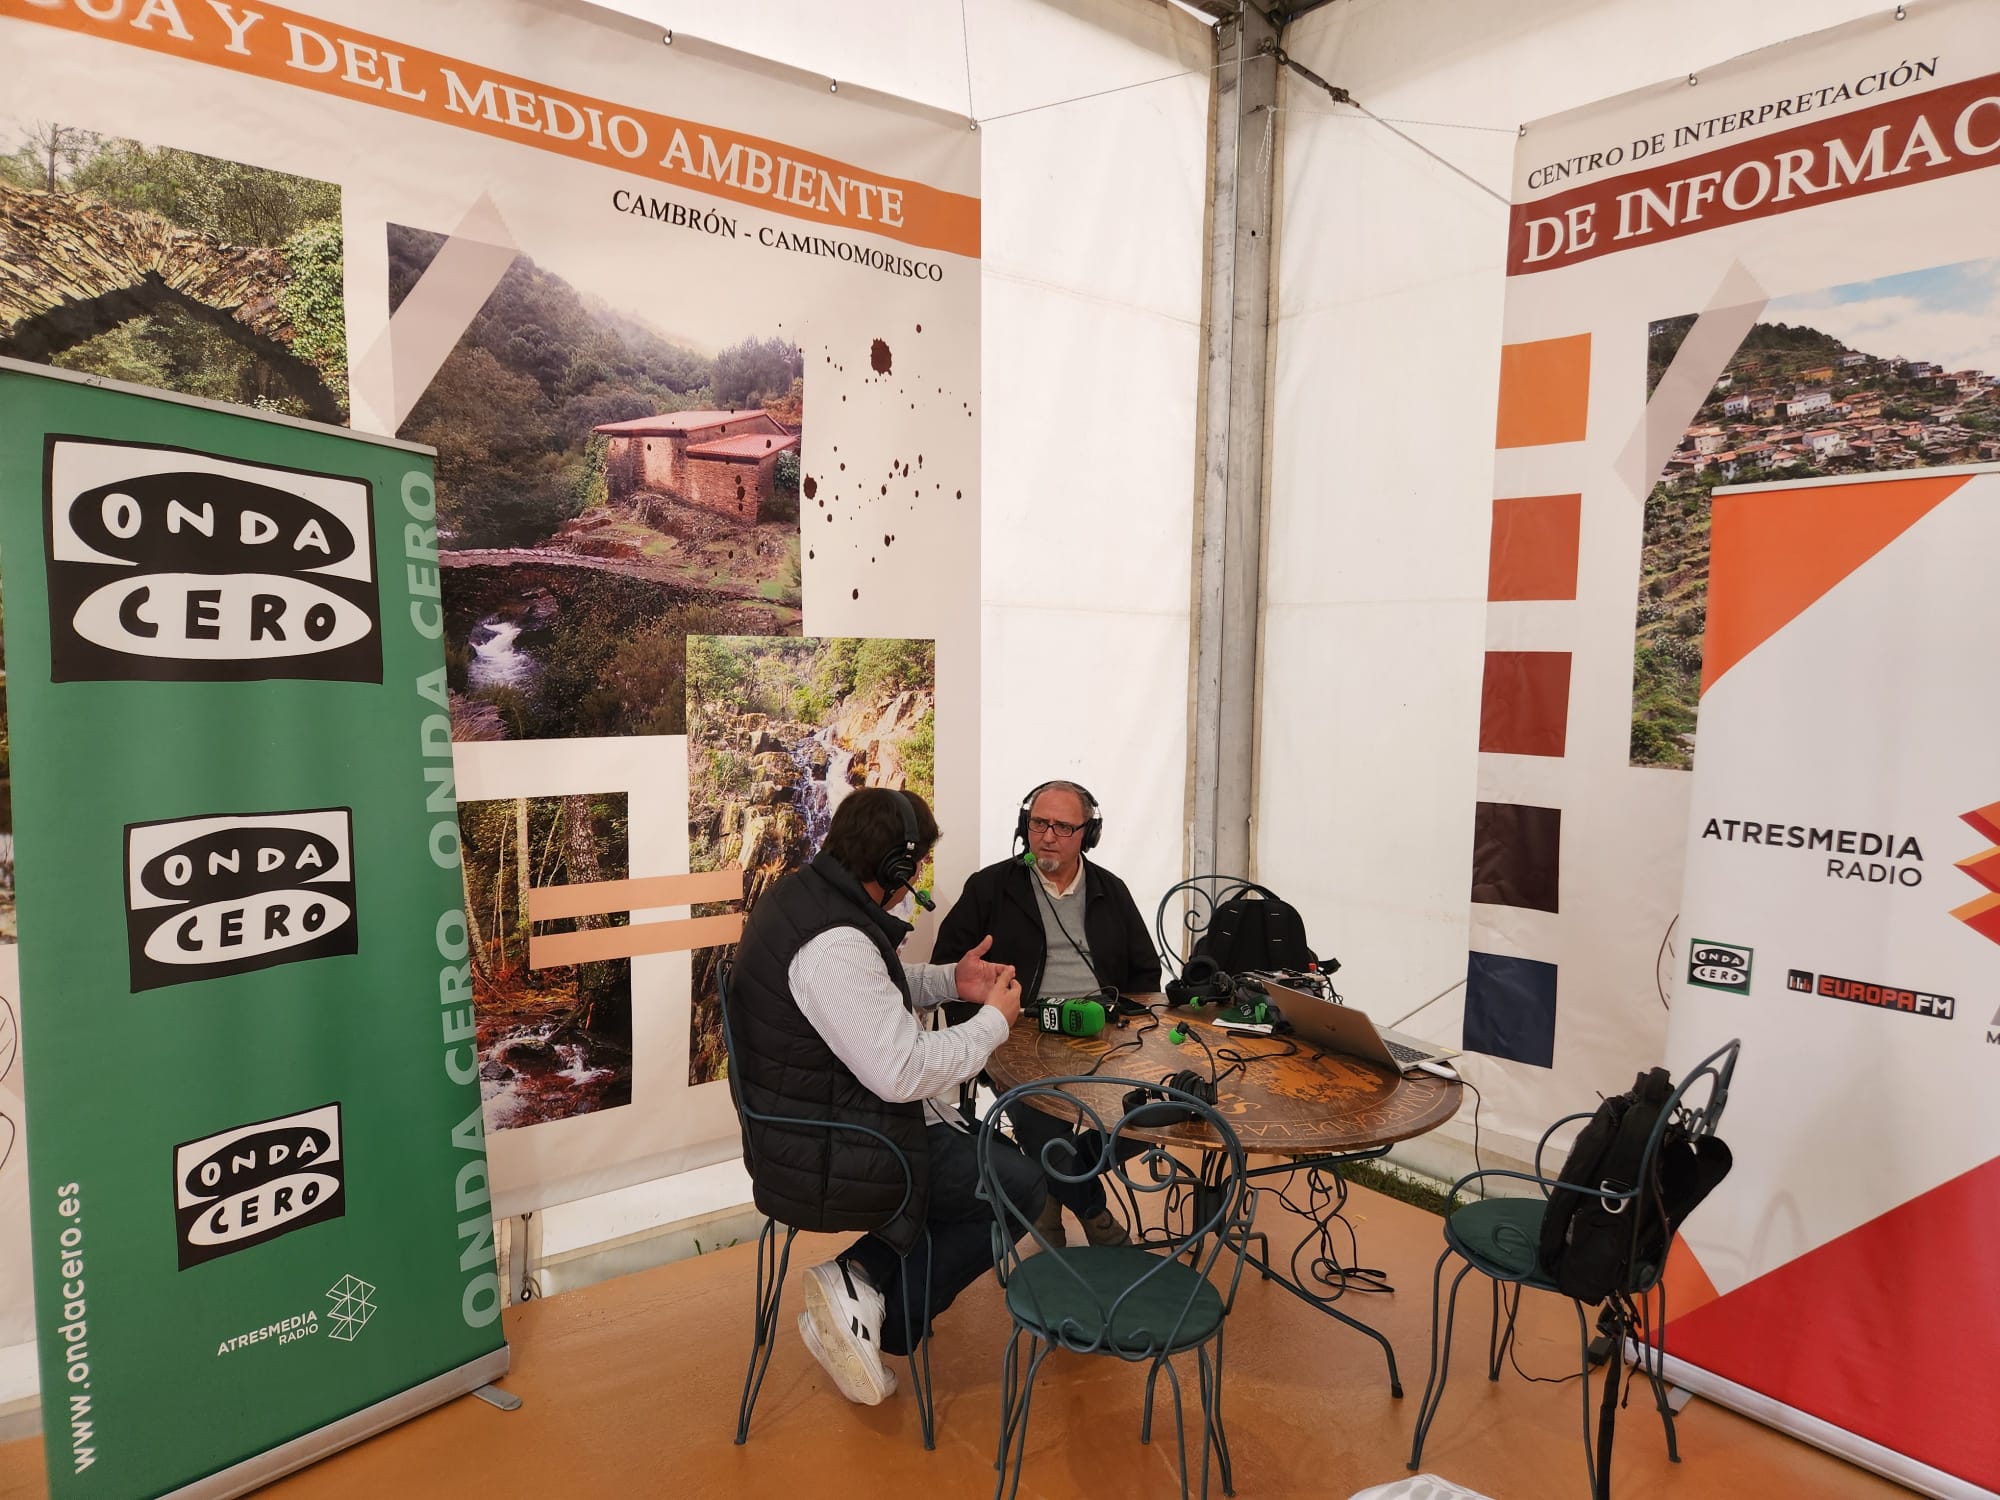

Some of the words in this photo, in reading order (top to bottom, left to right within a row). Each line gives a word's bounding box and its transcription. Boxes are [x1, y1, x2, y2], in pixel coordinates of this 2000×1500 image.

[204, 0, 266, 55] Y
[282, 23, 426, 103] DEL
[441, 68, 648, 159] MEDIO
[659, 127, 904, 228] AMBIENTE
[1527, 145, 1624, 191] CENTRO
[1631, 133, 1666, 161] DE
[1673, 56, 1941, 148] INTERPRETACIÓN
[612, 189, 738, 240] CAMBRÓN
[758, 227, 943, 282] CAMINOMORISCO
[1522, 203, 1597, 264] DE
[101, 492, 331, 555] ONDA
[401, 470, 444, 640] CERO
[118, 585, 337, 642] CERO
[415, 665, 463, 870] ONDA
[164, 842, 324, 887] ONDA
[1702, 817, 1924, 862] ATRESMEDIA
[1826, 859, 1923, 887] RADIO
[176, 902, 327, 952] CERO
[1699, 951, 1741, 966] ONDA
[1699, 967, 1739, 982] CERO
[436, 908, 480, 1086] CERO
[200, 1134, 319, 1187] ONDA
[209, 1179, 321, 1235] CERO
[451, 1107, 500, 1329] ONDA
[57, 1181, 96, 1475] www.ondacero.es
[217, 1310, 318, 1356] ATRESMEDIA
[279, 1323, 319, 1345] RADIO
